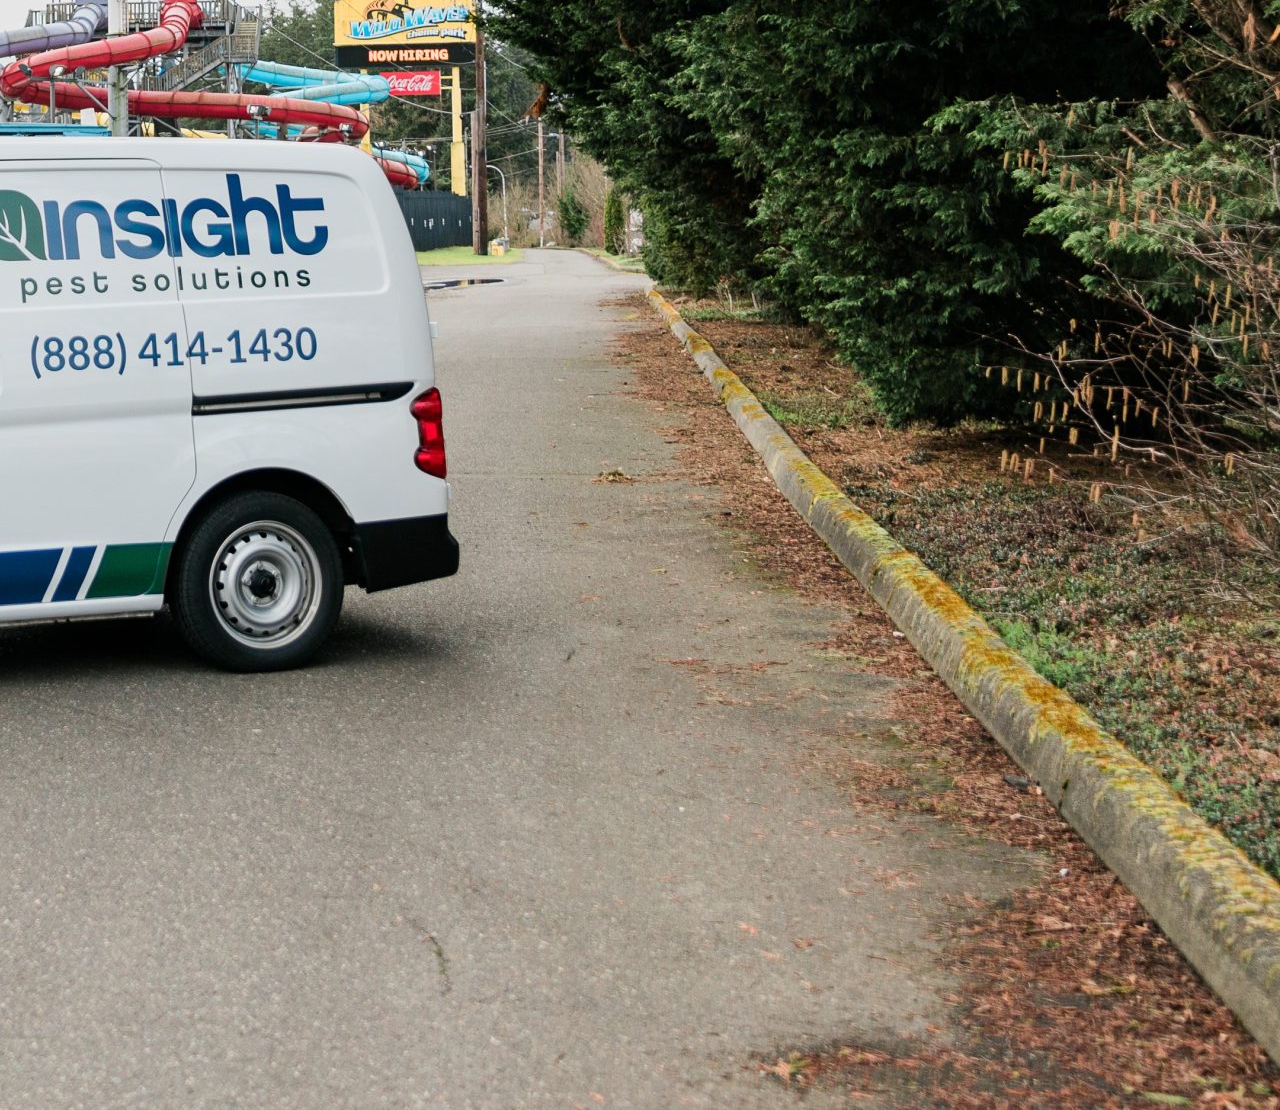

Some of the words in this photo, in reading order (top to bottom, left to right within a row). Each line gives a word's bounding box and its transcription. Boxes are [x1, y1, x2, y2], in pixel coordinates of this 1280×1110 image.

[441, 28, 465, 39] park
[368, 50, 398, 62] NOW
[399, 48, 449, 61] HIRING
[20, 271, 109, 303] pest
[132, 265, 312, 292] solutions
[30, 332, 128, 380] (888)
[138, 326, 318, 367] 414-1430
